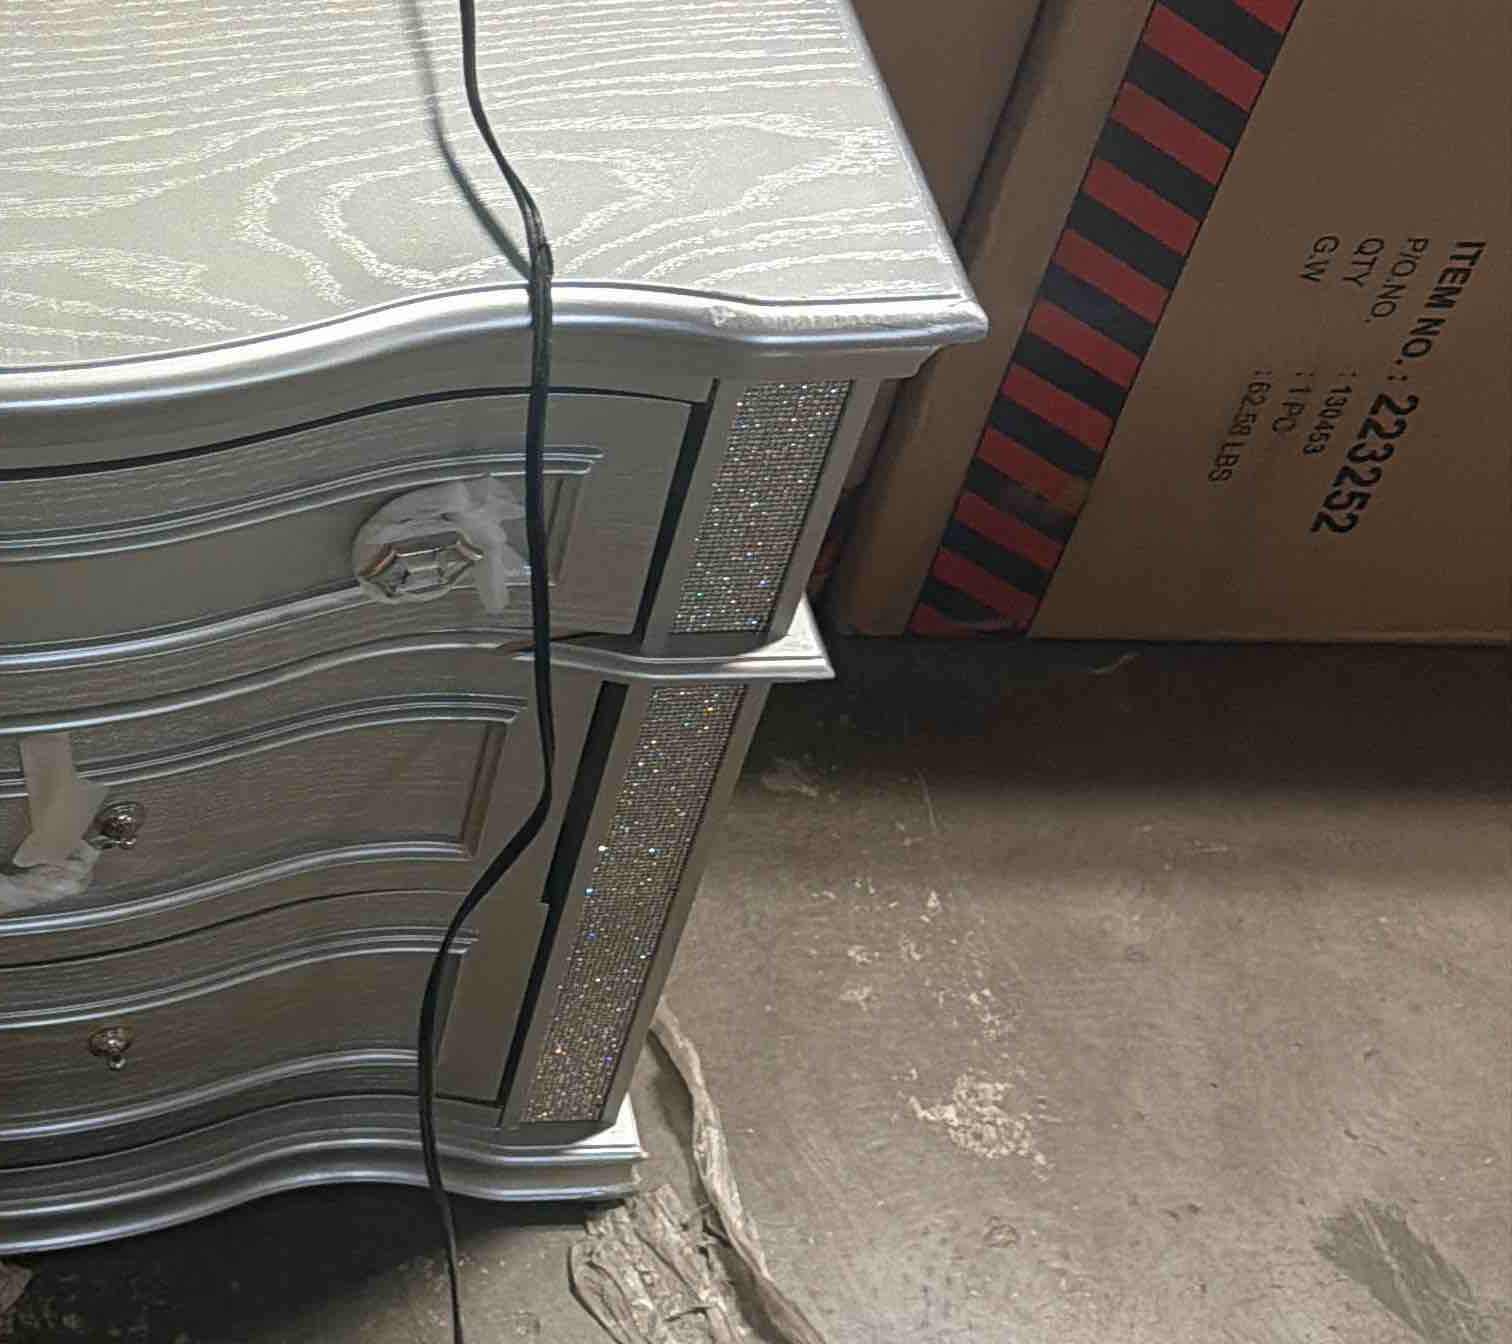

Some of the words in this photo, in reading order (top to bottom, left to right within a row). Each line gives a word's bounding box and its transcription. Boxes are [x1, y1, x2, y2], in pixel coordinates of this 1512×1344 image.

[1342, 238, 1386, 288] QTY
[1424, 241, 1487, 309] ITEM
[1395, 317, 1446, 365] NO.
[1272, 401, 1306, 434] PC
[1208, 441, 1246, 484] LBS
[1309, 394, 1420, 534] 223252
